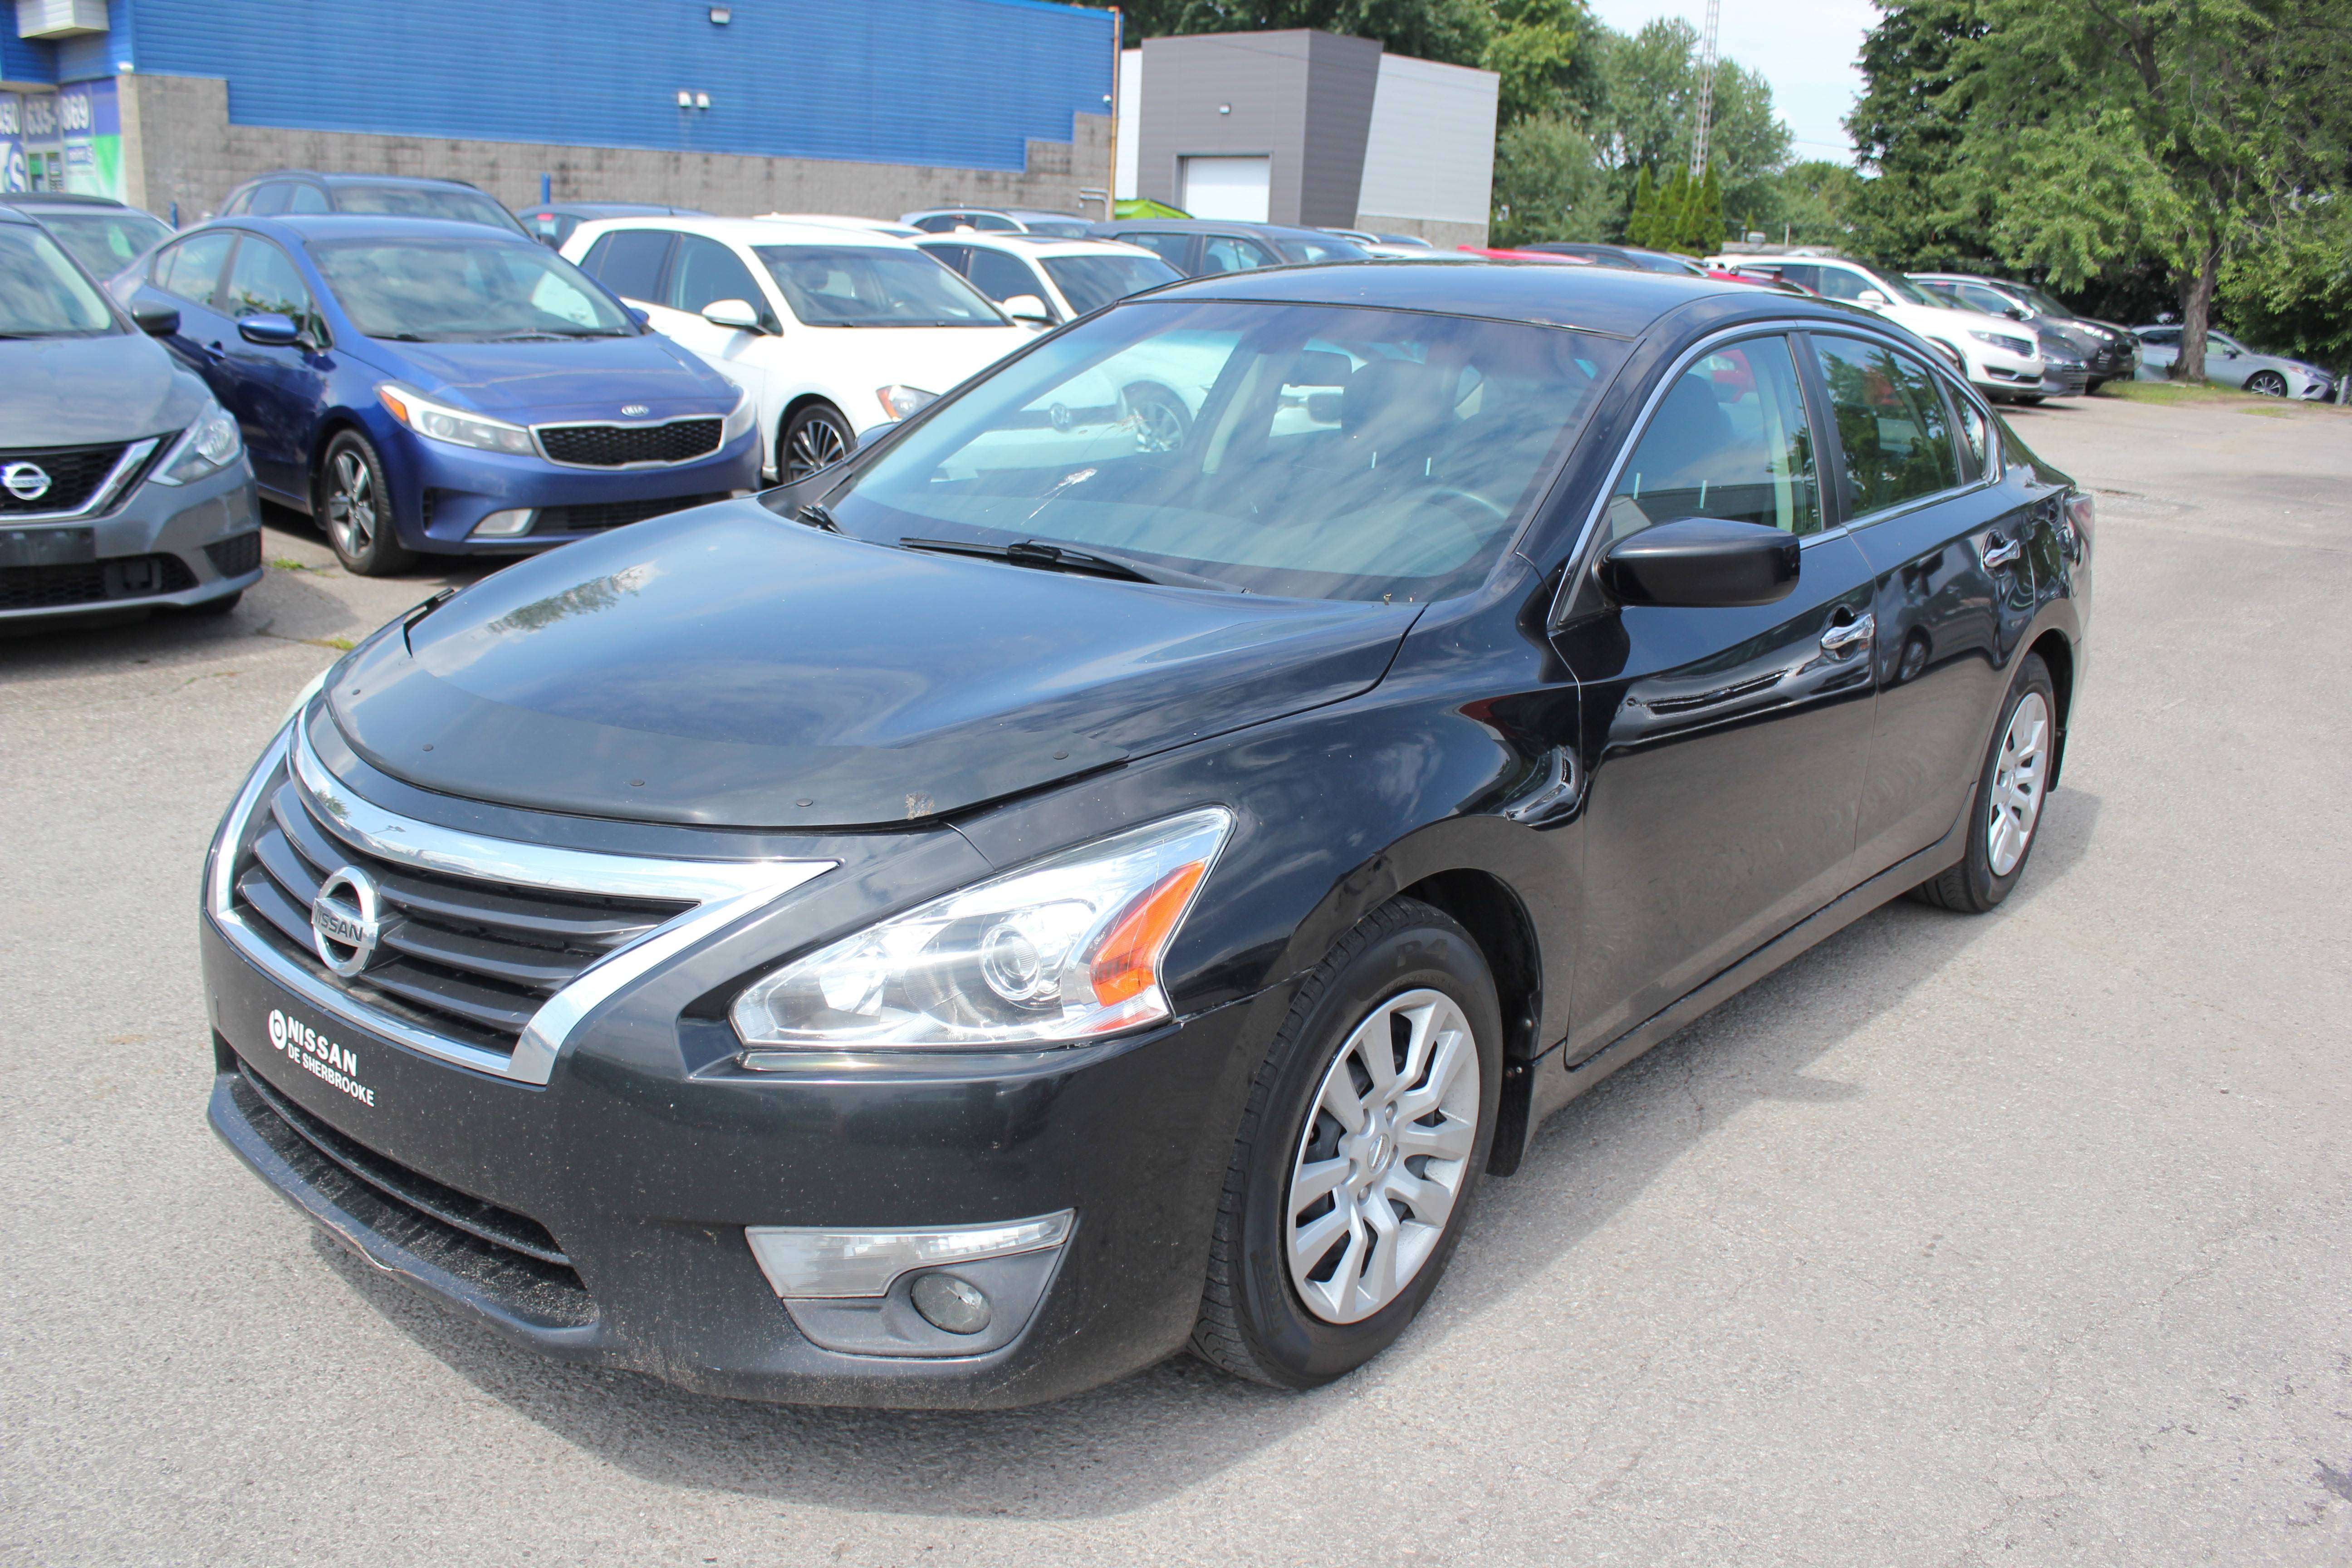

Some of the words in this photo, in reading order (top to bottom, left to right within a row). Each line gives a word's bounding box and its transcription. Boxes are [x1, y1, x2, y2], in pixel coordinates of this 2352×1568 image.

[622, 405, 647, 415] KIA
[313, 903, 364, 942] NISSAN
[288, 1016, 357, 1077] NISSAN
[288, 1043, 300, 1063] DE
[302, 1052, 375, 1107] SHERBROOKE
